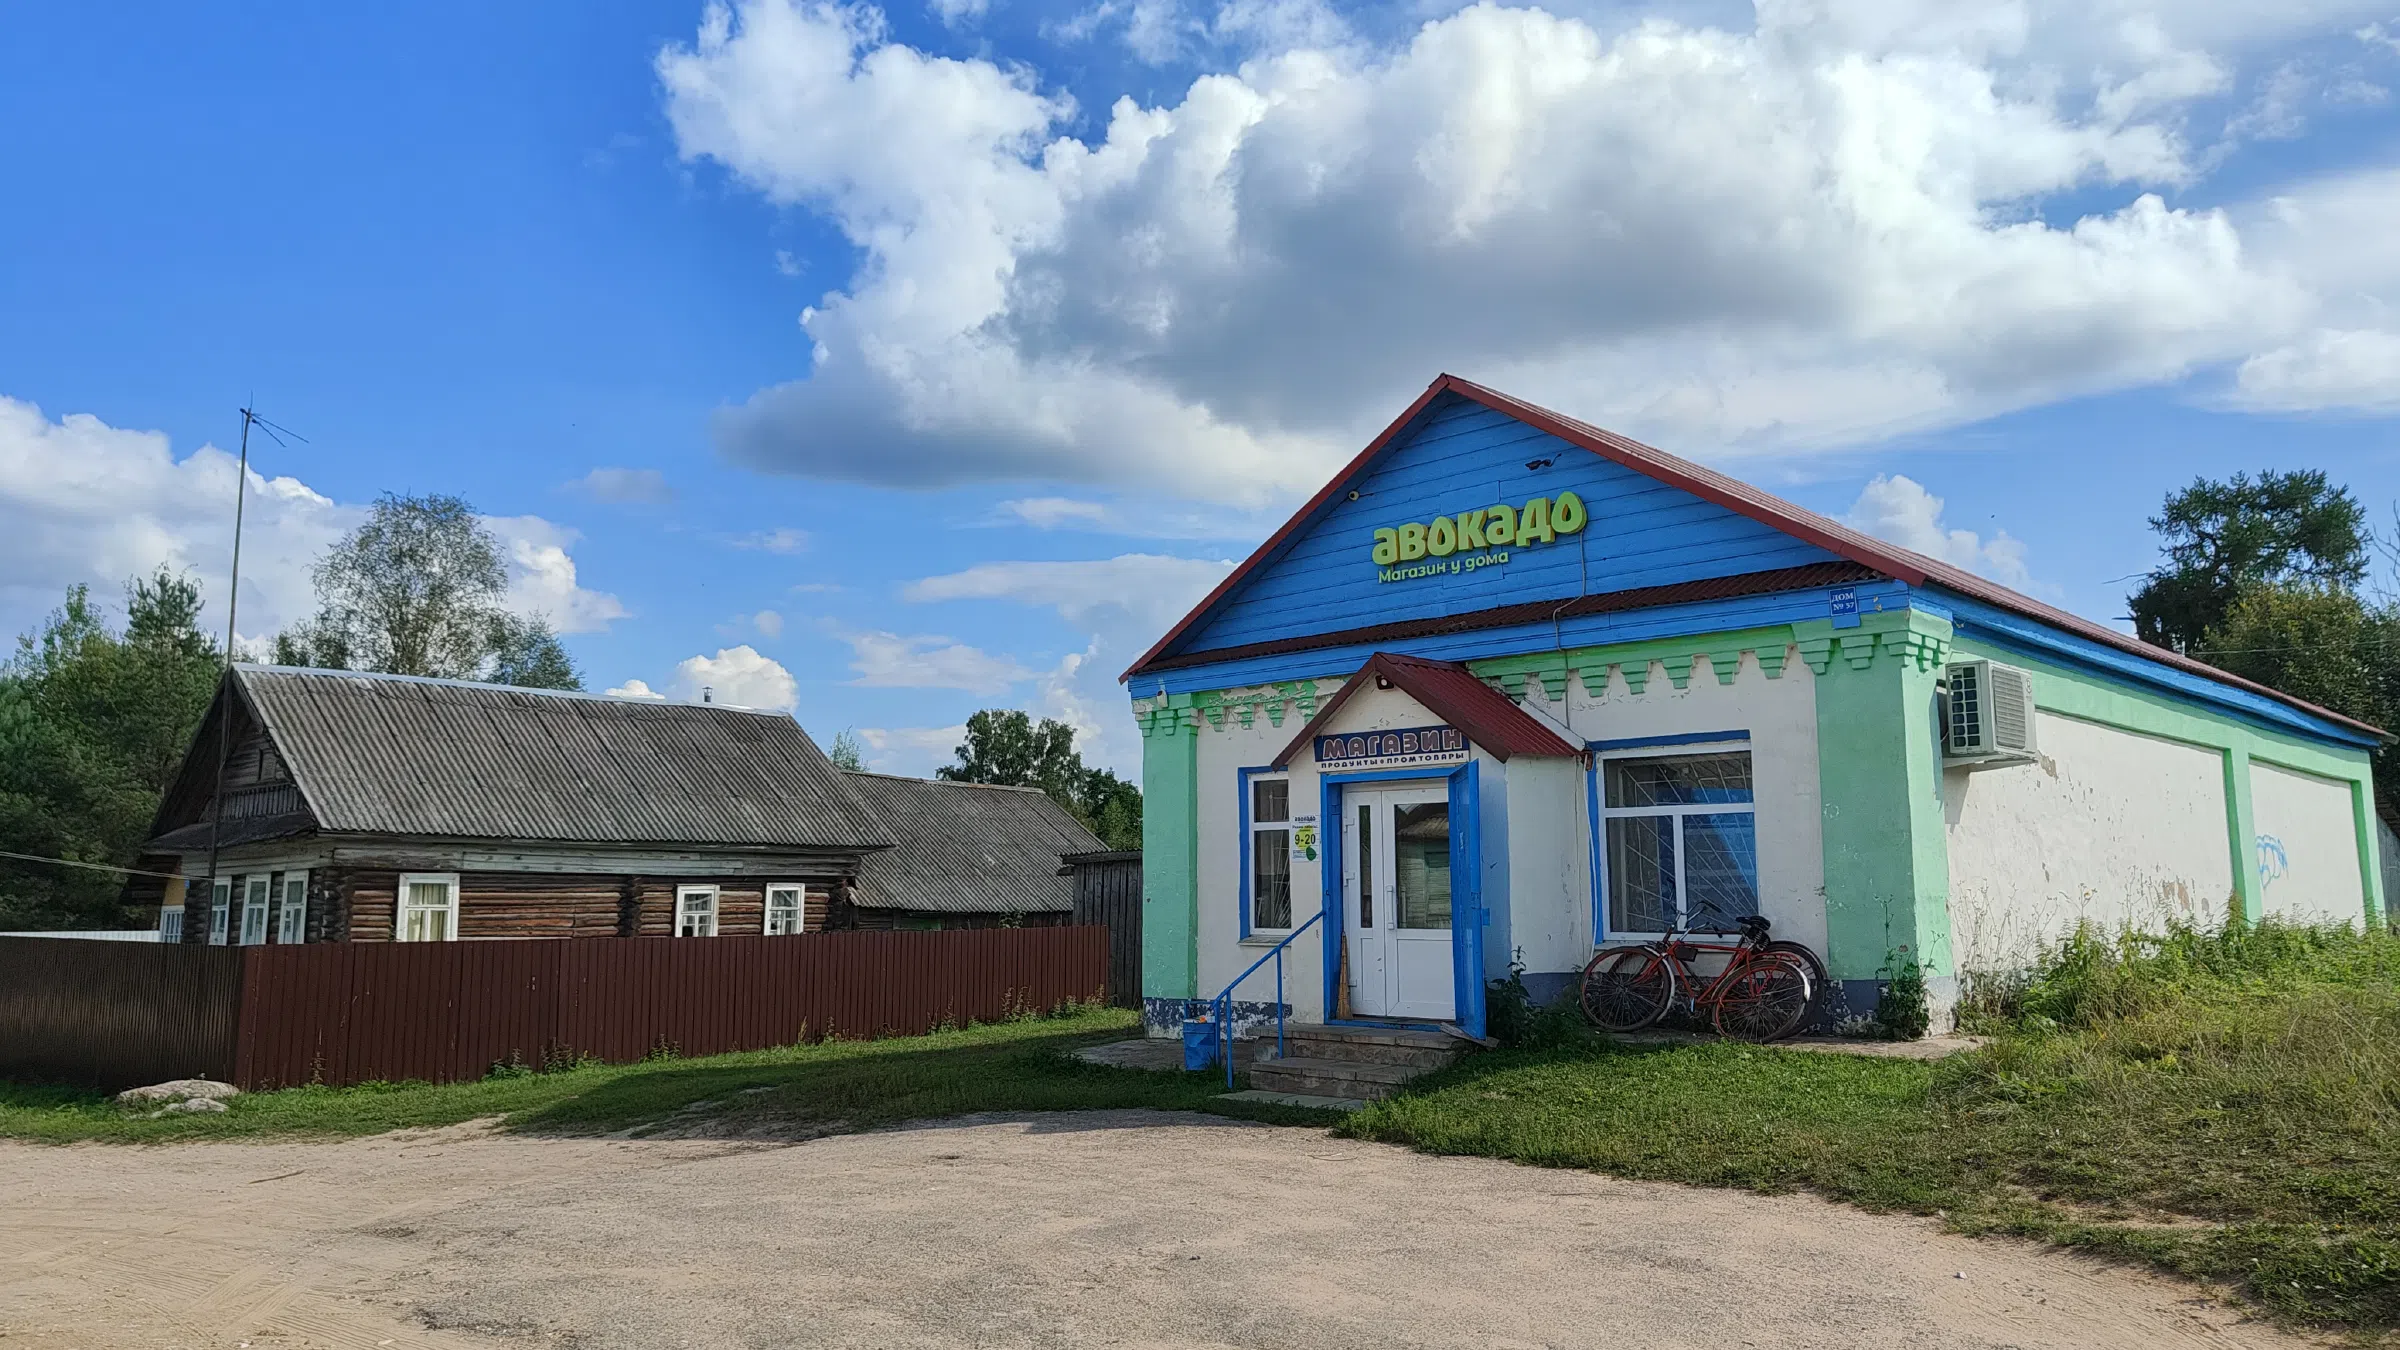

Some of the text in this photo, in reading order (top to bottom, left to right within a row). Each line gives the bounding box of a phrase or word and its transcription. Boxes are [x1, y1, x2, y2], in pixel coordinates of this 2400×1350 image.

[1379, 552, 1509, 583] Магазин у дома
[1832, 592, 1854, 602] ДОМ
[1323, 729, 1463, 759] МАГАЗИН
[1321, 753, 1464, 768] ПРОДУКТЫ ПРОМТОВАРЫ
